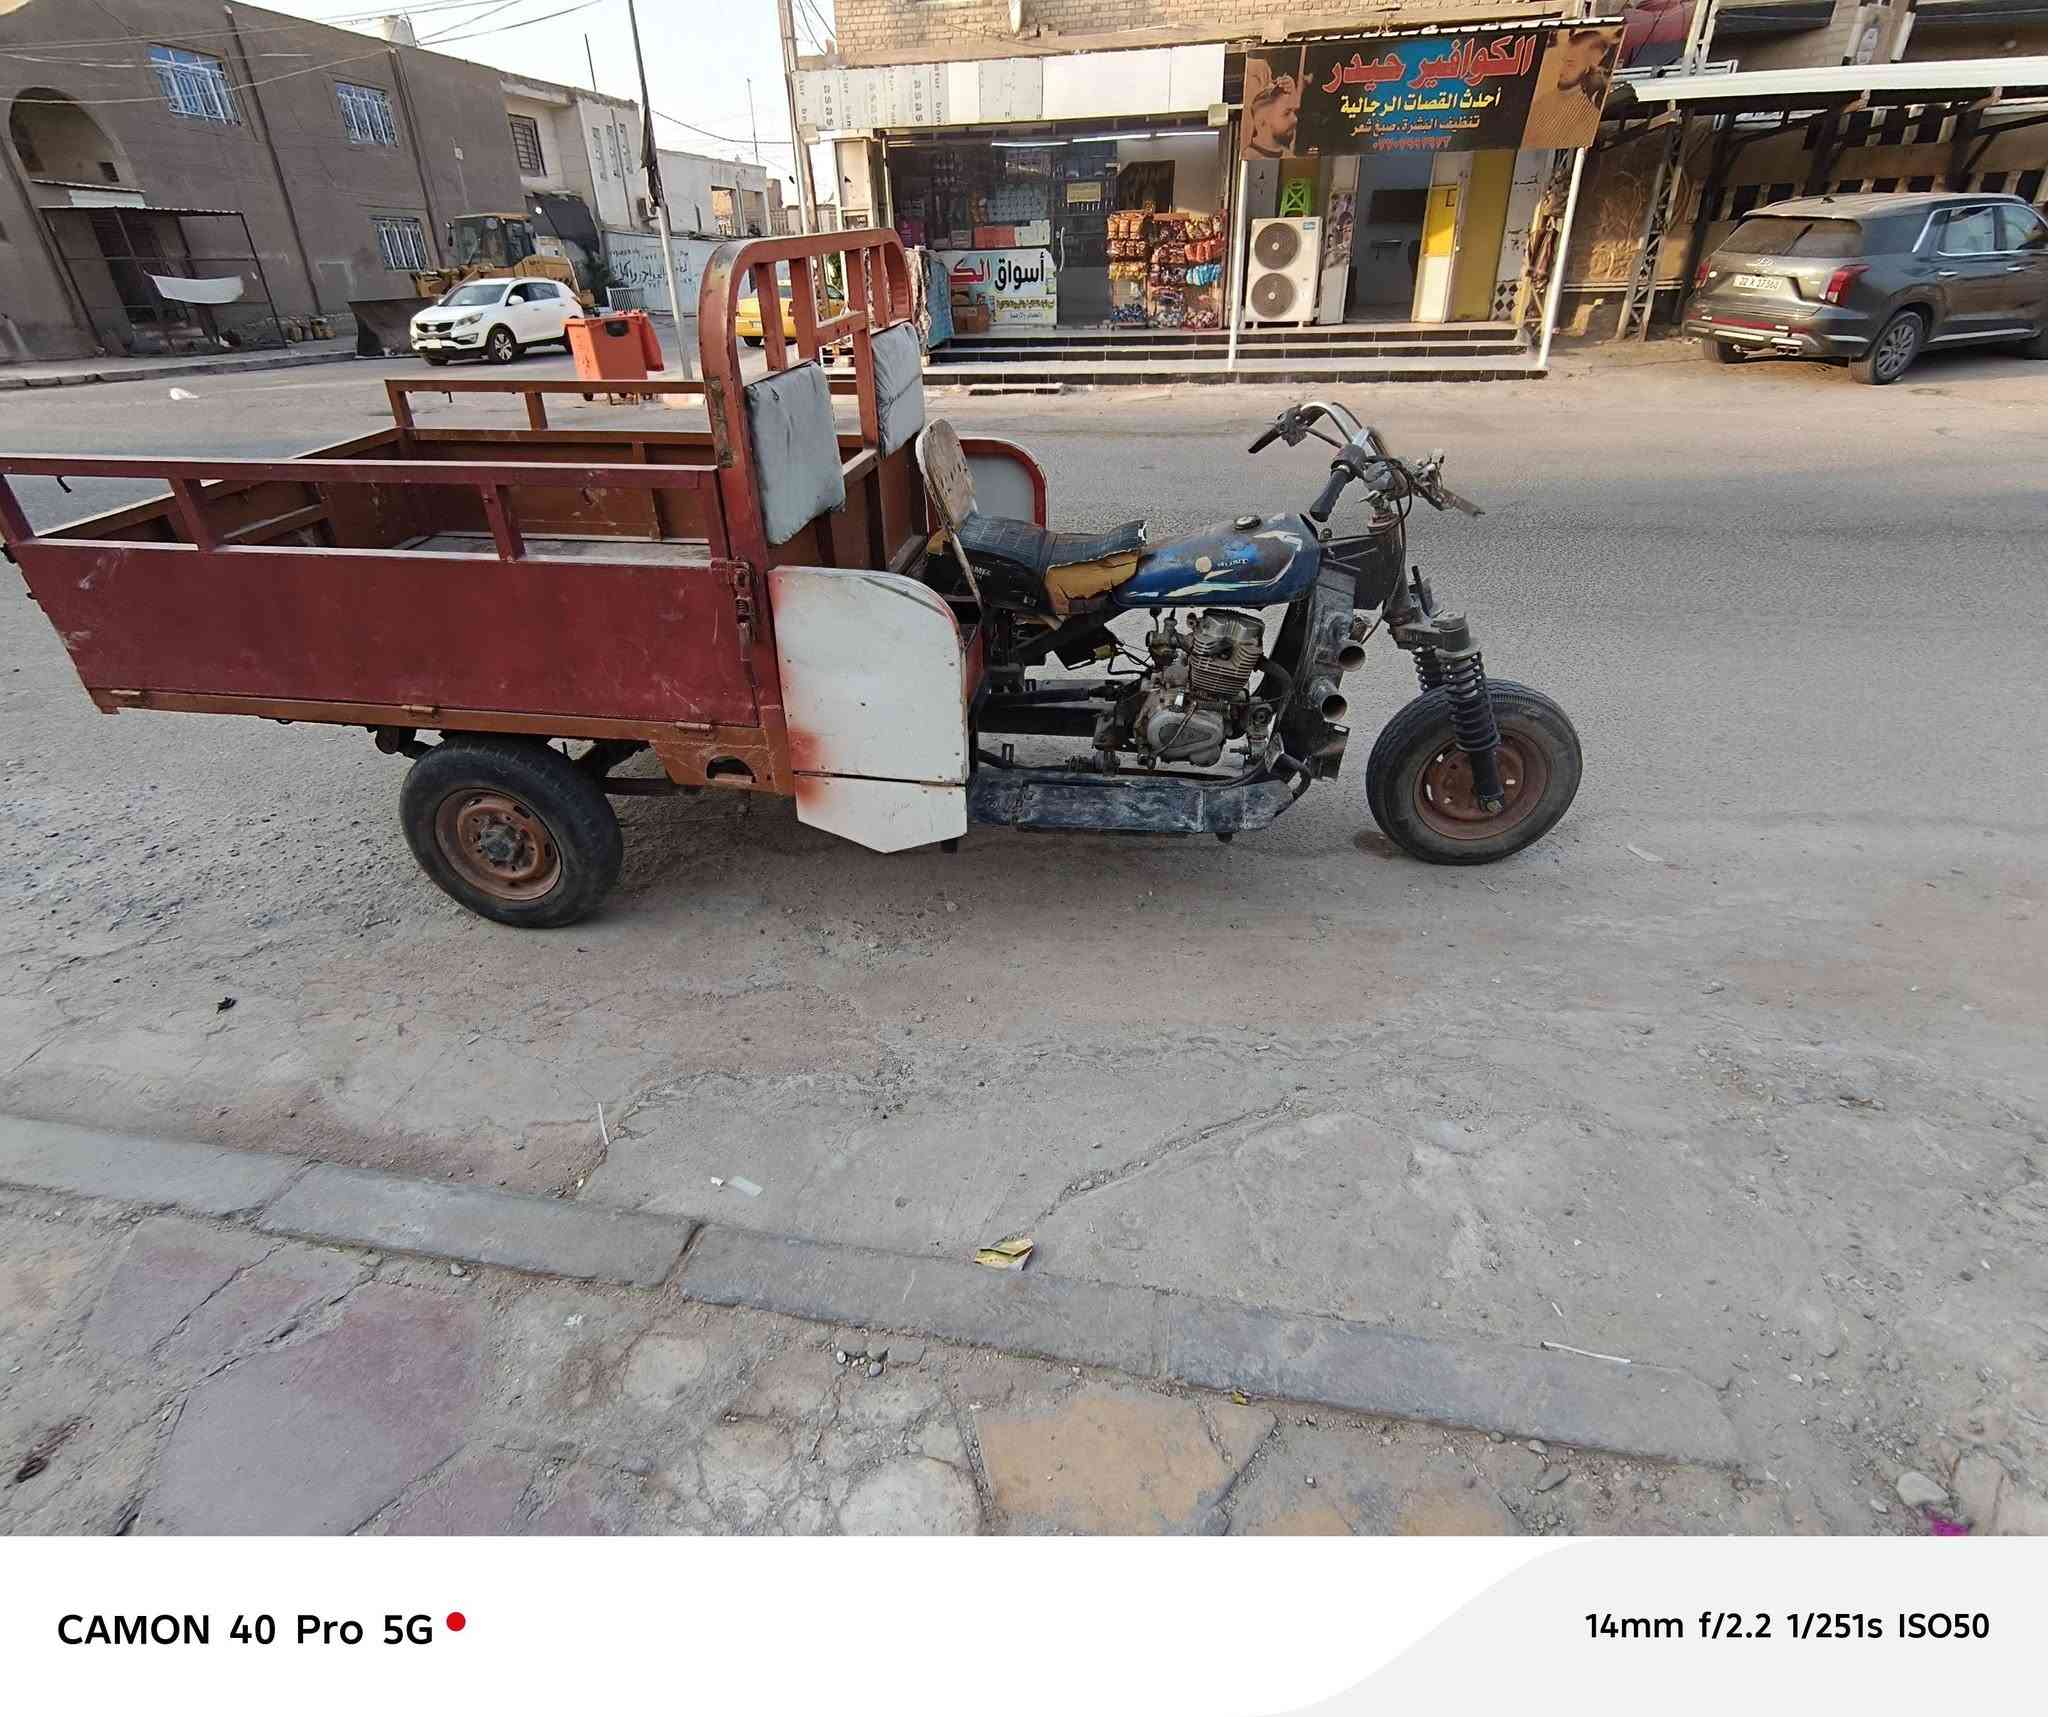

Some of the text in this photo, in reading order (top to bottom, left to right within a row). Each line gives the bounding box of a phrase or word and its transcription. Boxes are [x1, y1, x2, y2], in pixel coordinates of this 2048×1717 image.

[1321, 34, 1537, 93] الكوافير حيدر
[1340, 87, 1502, 118] أحدث القصات الرجالية
[1439, 115, 1480, 132] تنظيف
[949, 251, 1045, 291] أسواق الك
